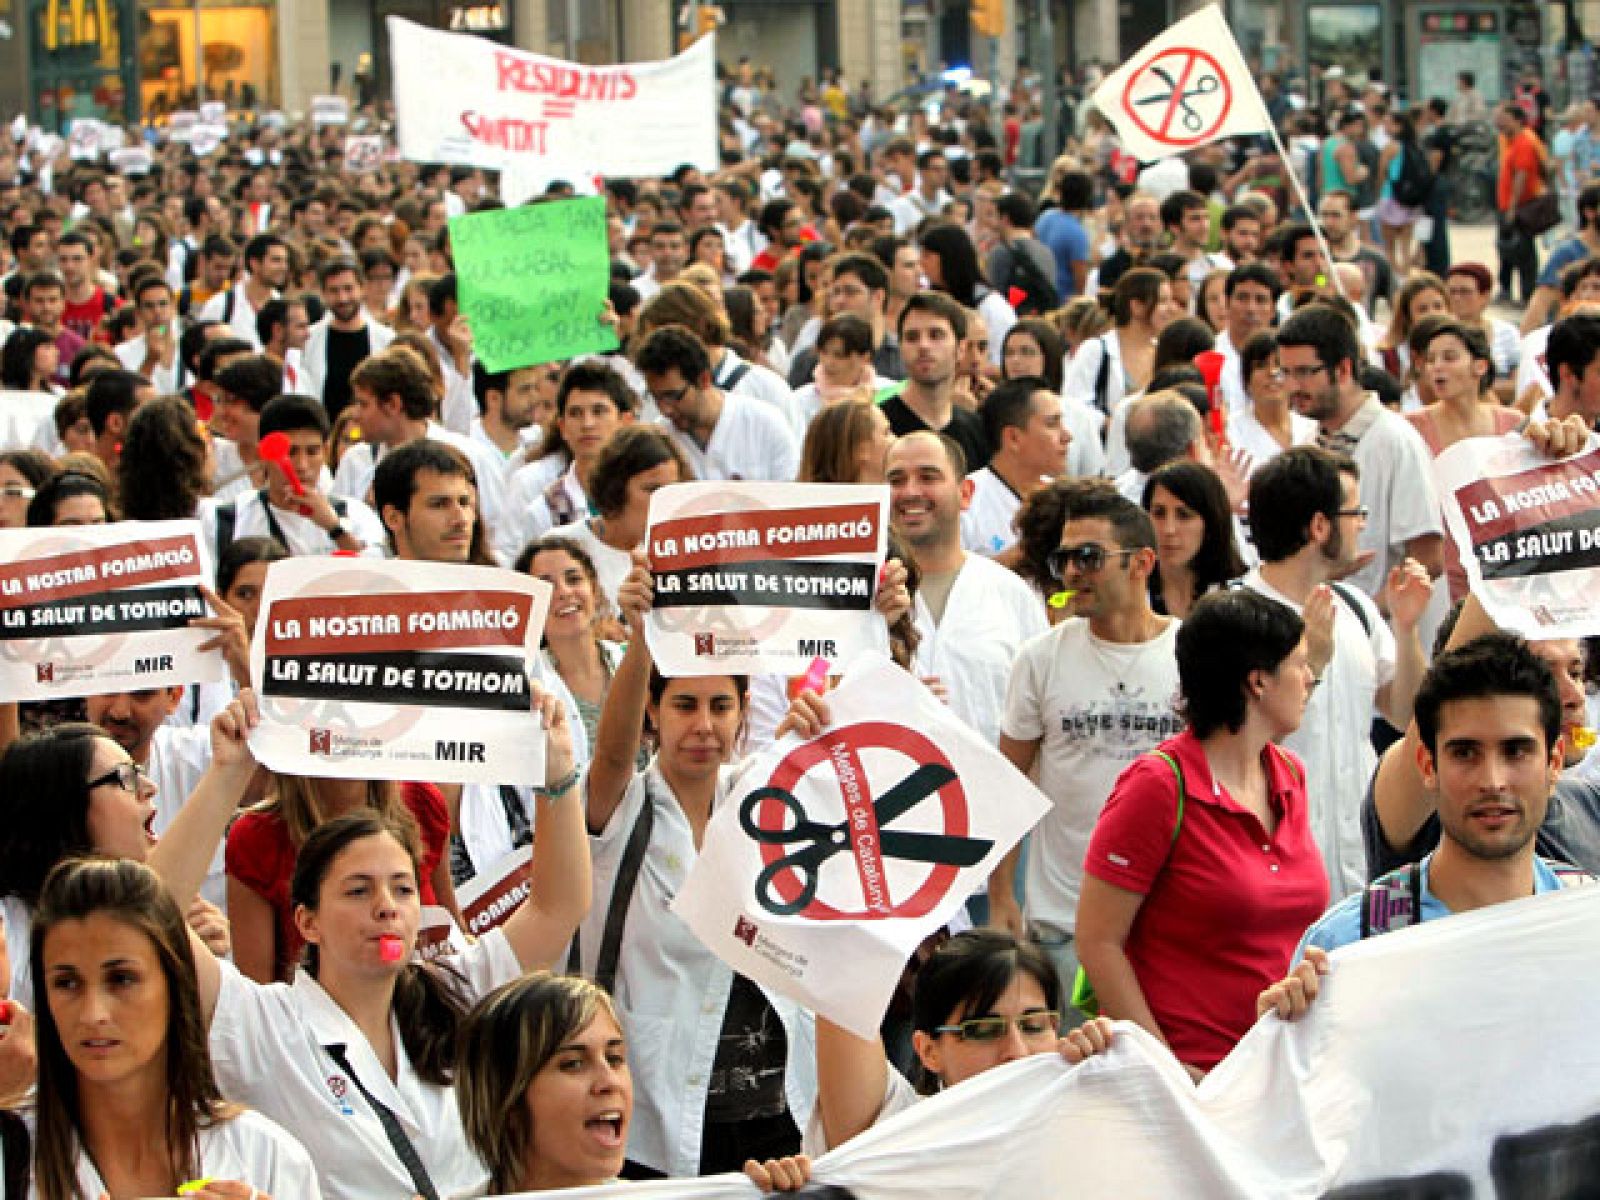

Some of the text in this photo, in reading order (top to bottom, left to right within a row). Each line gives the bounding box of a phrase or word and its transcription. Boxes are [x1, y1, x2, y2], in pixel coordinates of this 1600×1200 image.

[495, 51, 638, 100] RESIDENTS
[1469, 499, 1501, 524] LA
[1504, 483, 1569, 513] NOSTRA
[654, 515, 872, 558] LA NOSTRA FORMACIÓ
[1480, 541, 1510, 562] LA
[1516, 530, 1573, 559] SALUT
[1, 545, 193, 596] LA NOSTRA FORMACIÓ
[657, 573, 869, 597] LA SALUT DE TOTHOM
[3, 599, 201, 628] LA SALUT DE TOTHOM
[274, 605, 520, 640] LA NOSTRA FORMACIÓ
[134, 654, 174, 673] MIR
[798, 639, 838, 658] MIR
[272, 659, 523, 694] LA SALUT DE TOTHOM
[435, 739, 486, 763] MIR
